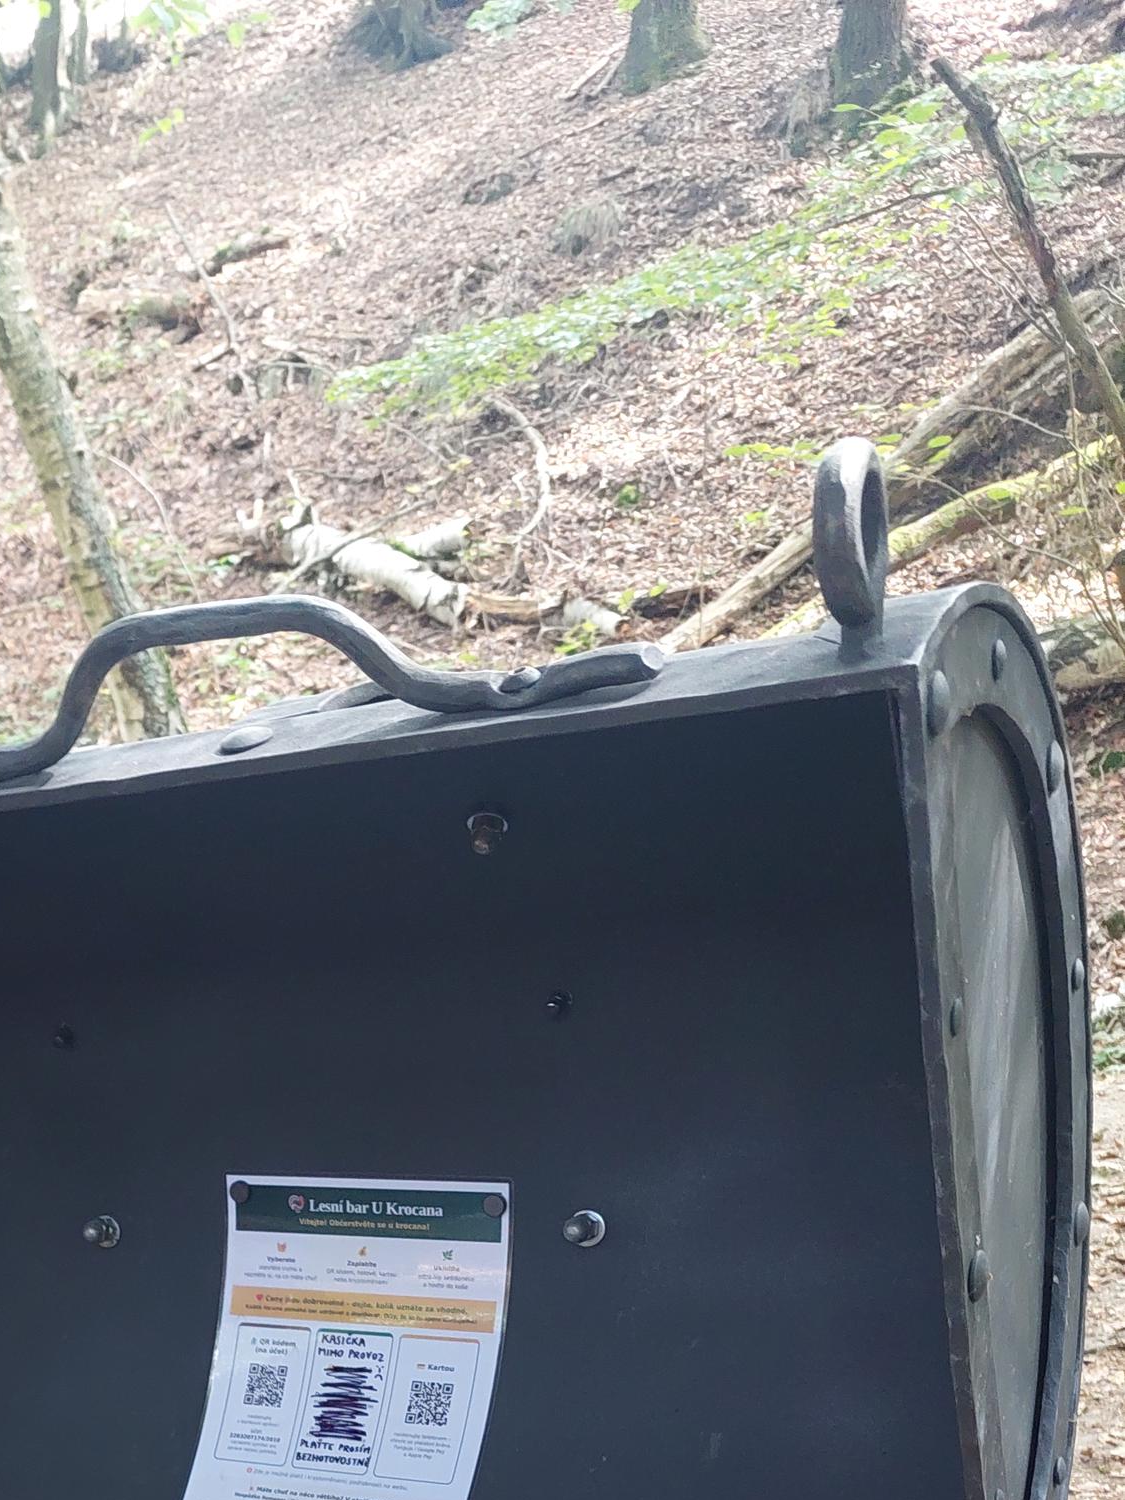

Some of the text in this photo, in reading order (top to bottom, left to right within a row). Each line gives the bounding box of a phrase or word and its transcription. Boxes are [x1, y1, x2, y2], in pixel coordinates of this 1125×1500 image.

[308, 1199, 444, 1218] Lesní bar U Krocana
[318, 1346, 386, 1362] MIMO PROVOZ
[428, 1363, 455, 1374] Kartou
[338, 1443, 371, 1455] PROSÍM
[296, 1451, 372, 1468] BEZHOTOVOSTNĚ
